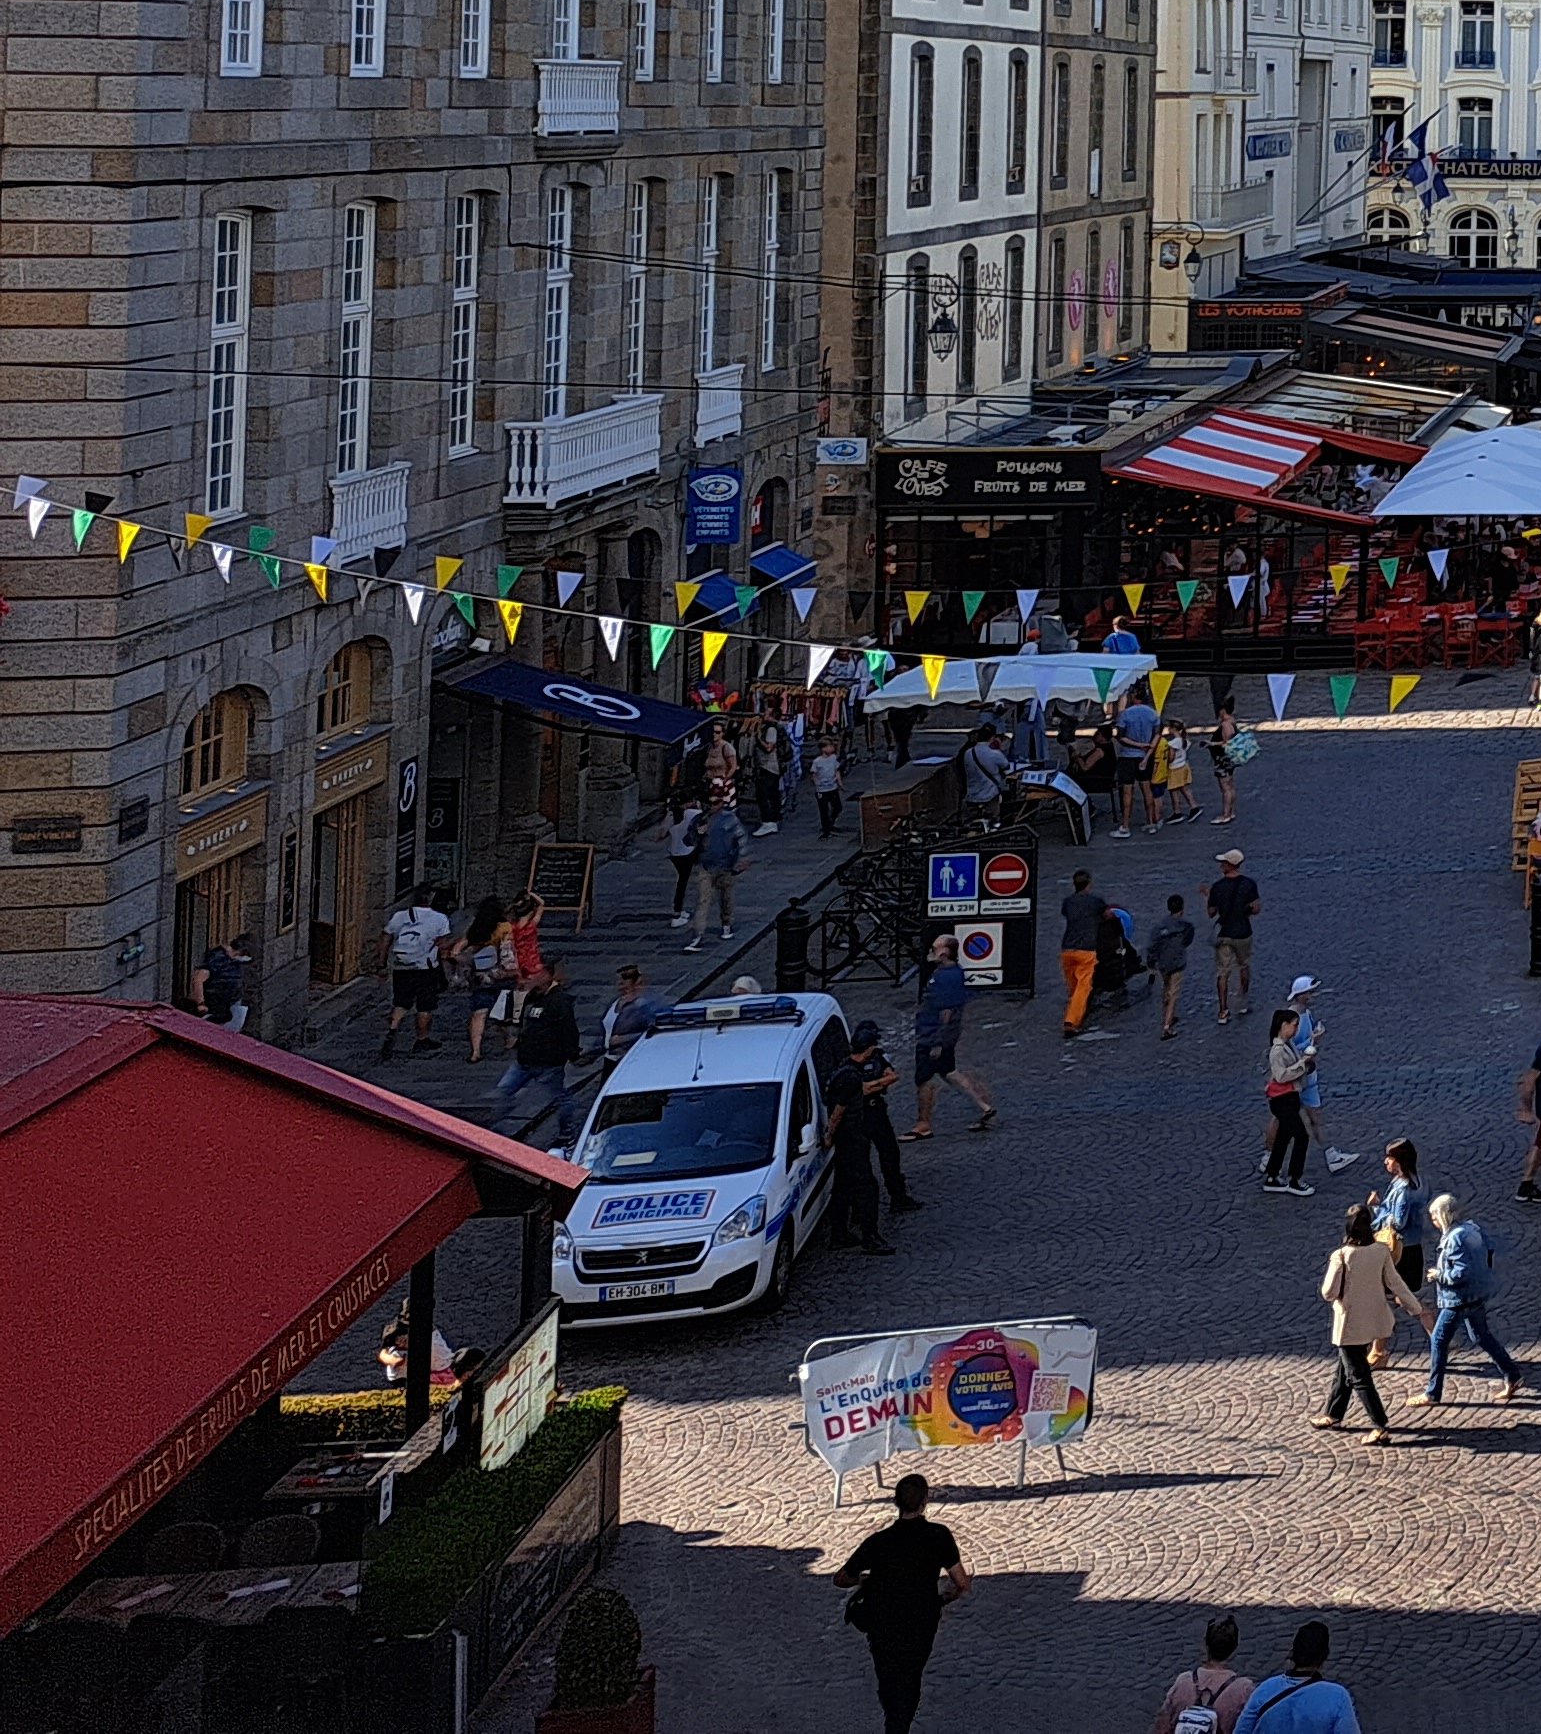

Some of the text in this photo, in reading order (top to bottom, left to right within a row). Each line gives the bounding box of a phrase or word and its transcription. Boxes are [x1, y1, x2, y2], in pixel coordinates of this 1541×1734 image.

[996, 460, 1063, 474] POISSONS
[974, 480, 1086, 493] FRUITS DE MER
[930, 904, 947, 914] 12H
[957, 904, 975, 913] 23H
[604, 1192, 707, 1214] POLICE
[600, 1206, 701, 1225] MUNICIPALE
[976, 1338, 995, 1351] 30
[911, 1372, 933, 1388] de
[959, 1369, 1010, 1385] DONNEZ
[815, 1373, 876, 1398] Saint-Malo
[955, 1381, 1014, 1395] VOTRE AVIS
[74, 1252, 390, 1561] SPECIALITES DE FRUITS DE MER ET CRUSTACES
[824, 1391, 934, 1441] DEMAIN
